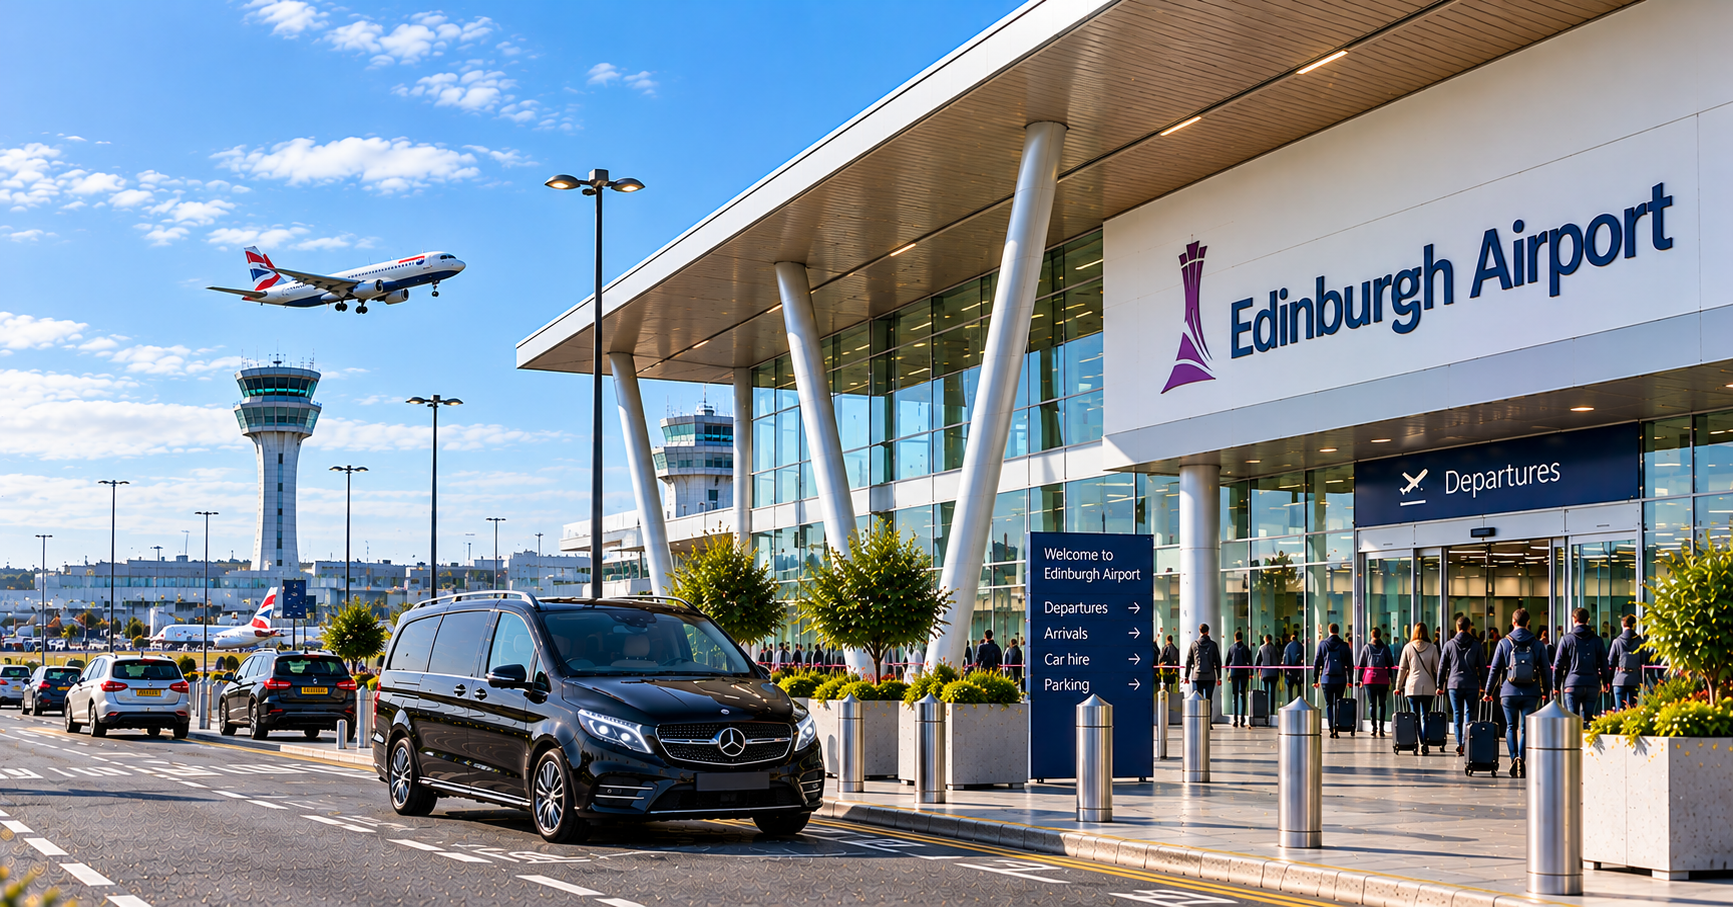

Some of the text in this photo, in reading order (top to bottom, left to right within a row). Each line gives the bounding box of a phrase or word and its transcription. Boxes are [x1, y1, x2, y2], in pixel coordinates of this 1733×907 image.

[1231, 182, 1674, 360] Edinburgh Airport
[1446, 462, 1561, 499] Departures
[1044, 547, 1114, 561] Welcome to
[1044, 566, 1141, 583] Edinburgh Airport
[1044, 601, 1109, 617] Departures
[1044, 626, 1088, 640] Arrivals
[1044, 652, 1090, 666] Car hire
[1044, 678, 1090, 694] Parking
